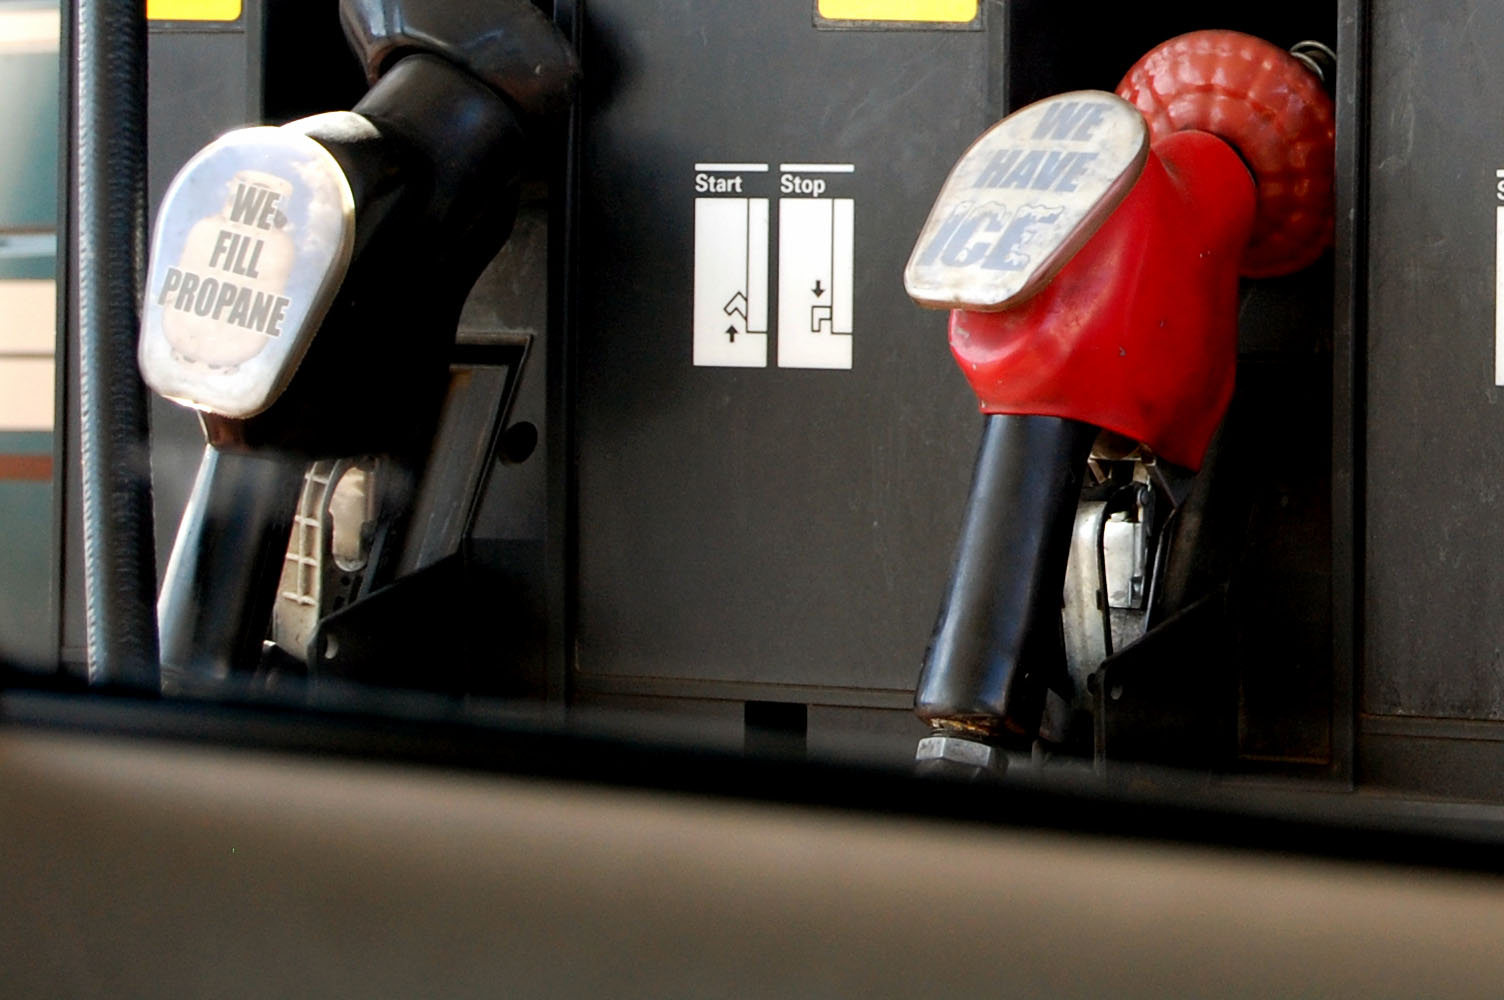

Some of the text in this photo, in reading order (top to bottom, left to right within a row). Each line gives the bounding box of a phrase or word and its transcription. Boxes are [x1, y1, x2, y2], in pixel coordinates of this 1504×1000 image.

[1031, 101, 1114, 141] WE
[695, 173, 743, 193] Start
[780, 174, 826, 197] Stop
[973, 149, 1100, 192] HAVE
[229, 183, 282, 230] WE
[208, 229, 266, 279] FILL
[915, 200, 1065, 271] ICE
[157, 267, 290, 337] PROPANE
